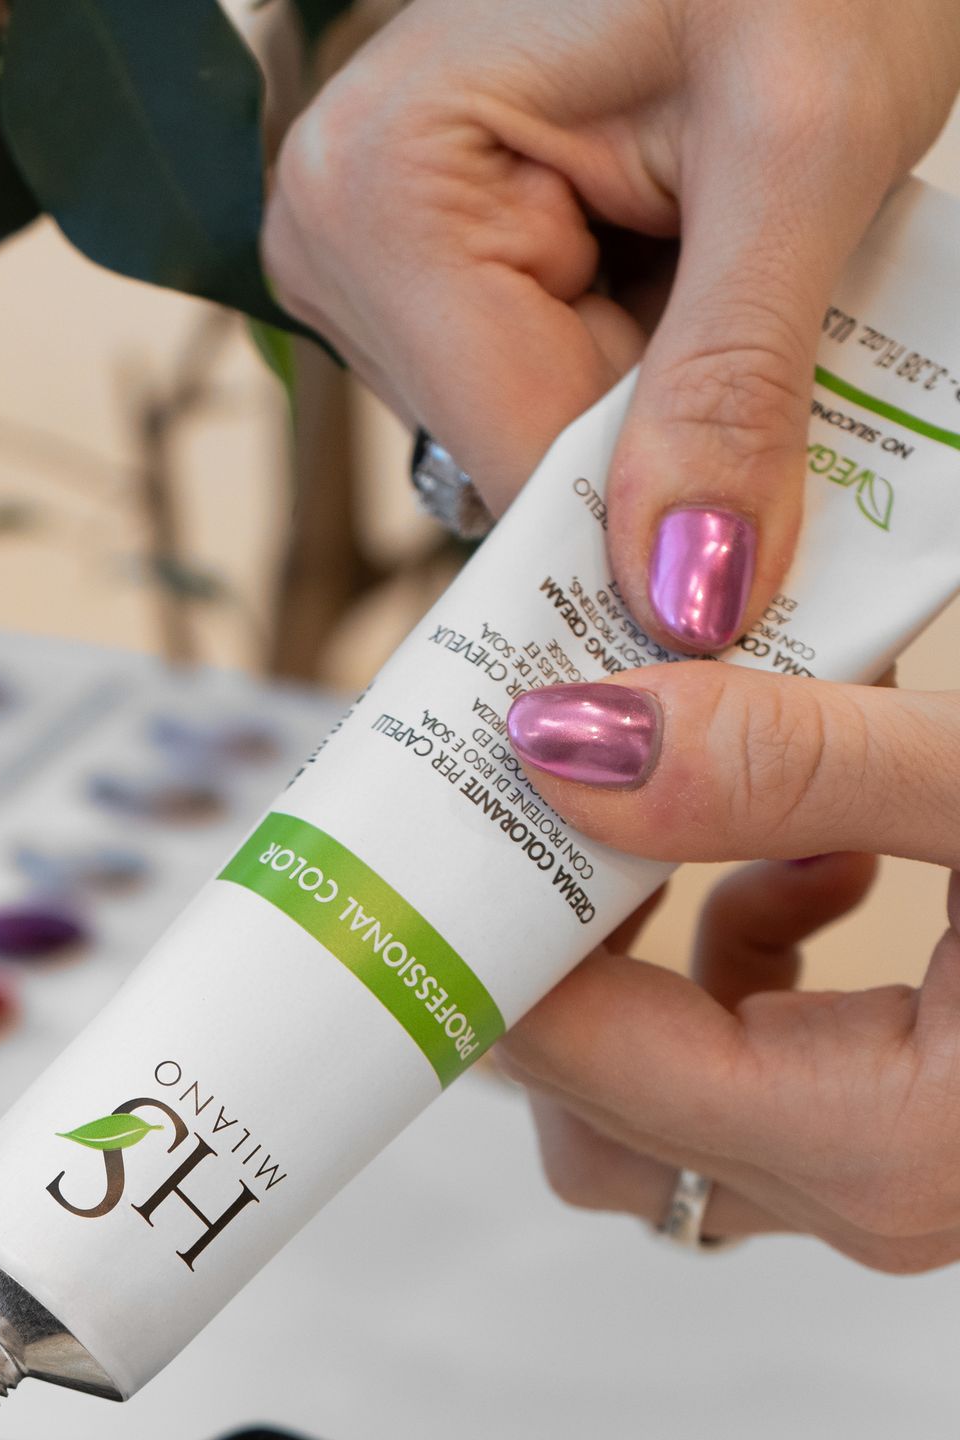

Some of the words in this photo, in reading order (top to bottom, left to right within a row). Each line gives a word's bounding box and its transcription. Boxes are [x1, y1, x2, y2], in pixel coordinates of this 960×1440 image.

[880, 437, 915, 460] NO
[539, 575, 588, 638] CREAM
[568, 575, 619, 645] PROTEINS,
[595, 589, 624, 621] AND
[480, 622, 517, 659] SOJA,
[522, 641, 542, 660] ET
[618, 619, 649, 648] OILS
[777, 634, 817, 662] CON
[428, 625, 508, 682] CHEVEUX
[511, 654, 533, 678] DE
[614, 642, 647, 669] SOY
[371, 713, 434, 757] CAPELLI
[421, 709, 456, 744] SOIA,
[471, 727, 494, 749] ED
[450, 737, 467, 753] E
[430, 749, 467, 785] PER
[463, 748, 497, 780] RISO
[491, 773, 512, 794] DI
[458, 775, 556, 871] COLORANTE
[505, 787, 568, 849] PROTEINE
[258, 841, 339, 903] COLOR
[561, 842, 594, 881] CON
[551, 863, 596, 925] CREMA
[338, 896, 480, 1061] PROFESSIONAL
[154, 1060, 288, 1191] MILANO
[46, 1097, 260, 1272] HS
